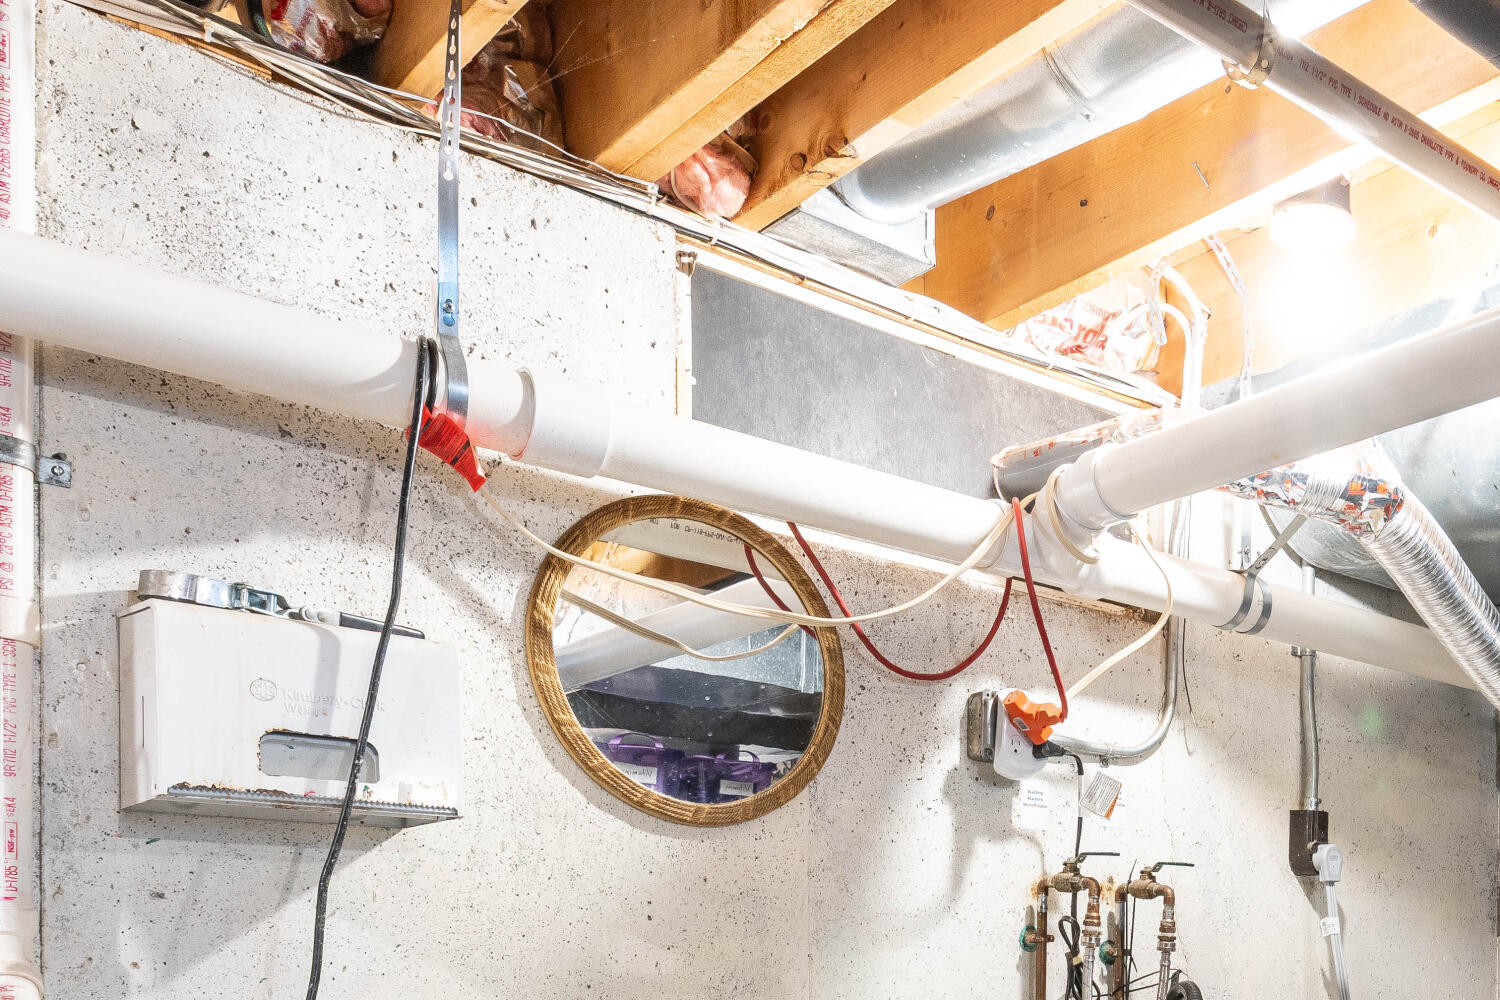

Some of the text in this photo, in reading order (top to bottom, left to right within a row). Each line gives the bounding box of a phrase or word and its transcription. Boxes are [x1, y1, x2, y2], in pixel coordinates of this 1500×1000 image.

[1357, 95, 1381, 117] SCHEDULE
[2, 672, 17, 693] TYPE
[3, 697, 17, 714] PVC
